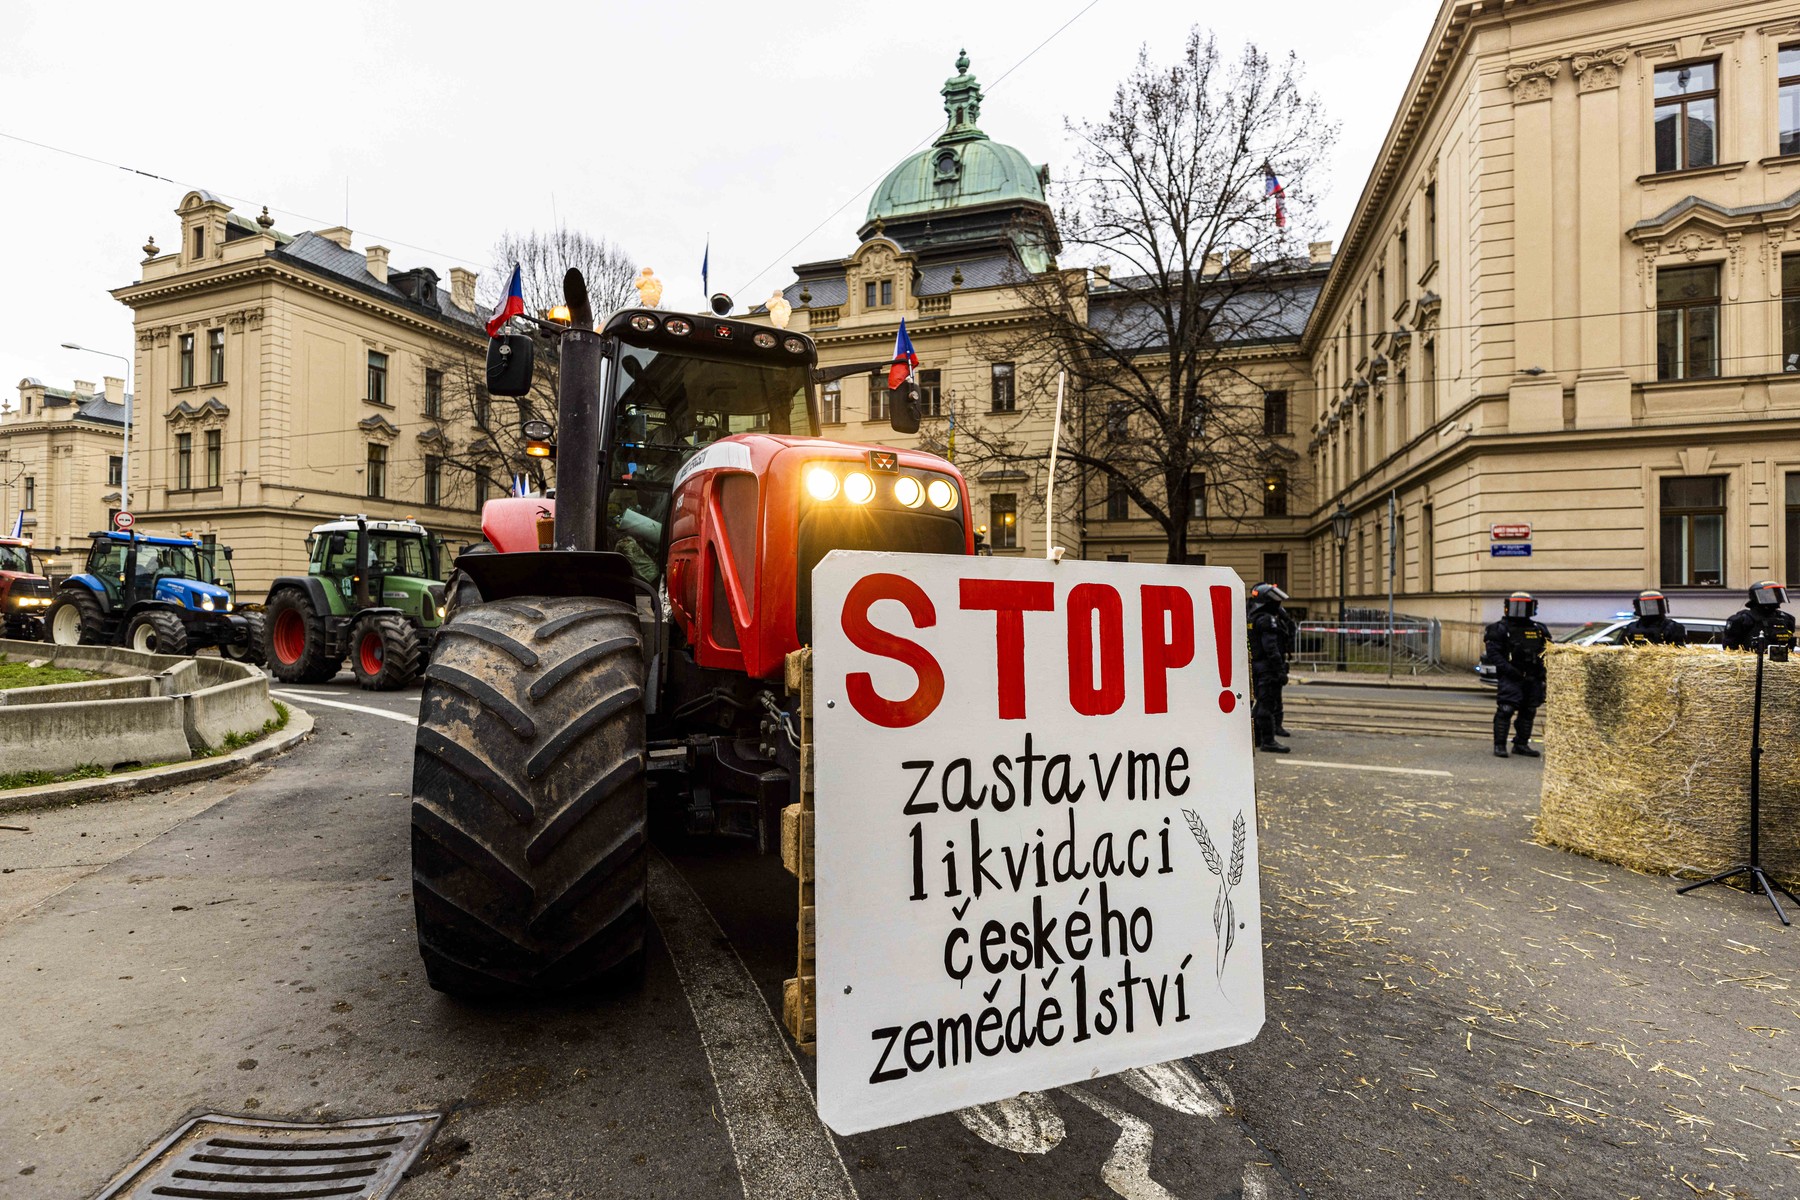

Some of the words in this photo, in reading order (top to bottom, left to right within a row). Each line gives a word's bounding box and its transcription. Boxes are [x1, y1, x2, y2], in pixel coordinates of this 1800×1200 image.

[840, 572, 1236, 729] STOP!
[901, 732, 1192, 817] zastavme
[908, 807, 1175, 902] likvidaci
[943, 880, 1154, 990] českého
[868, 953, 1194, 1085] zemědělství
